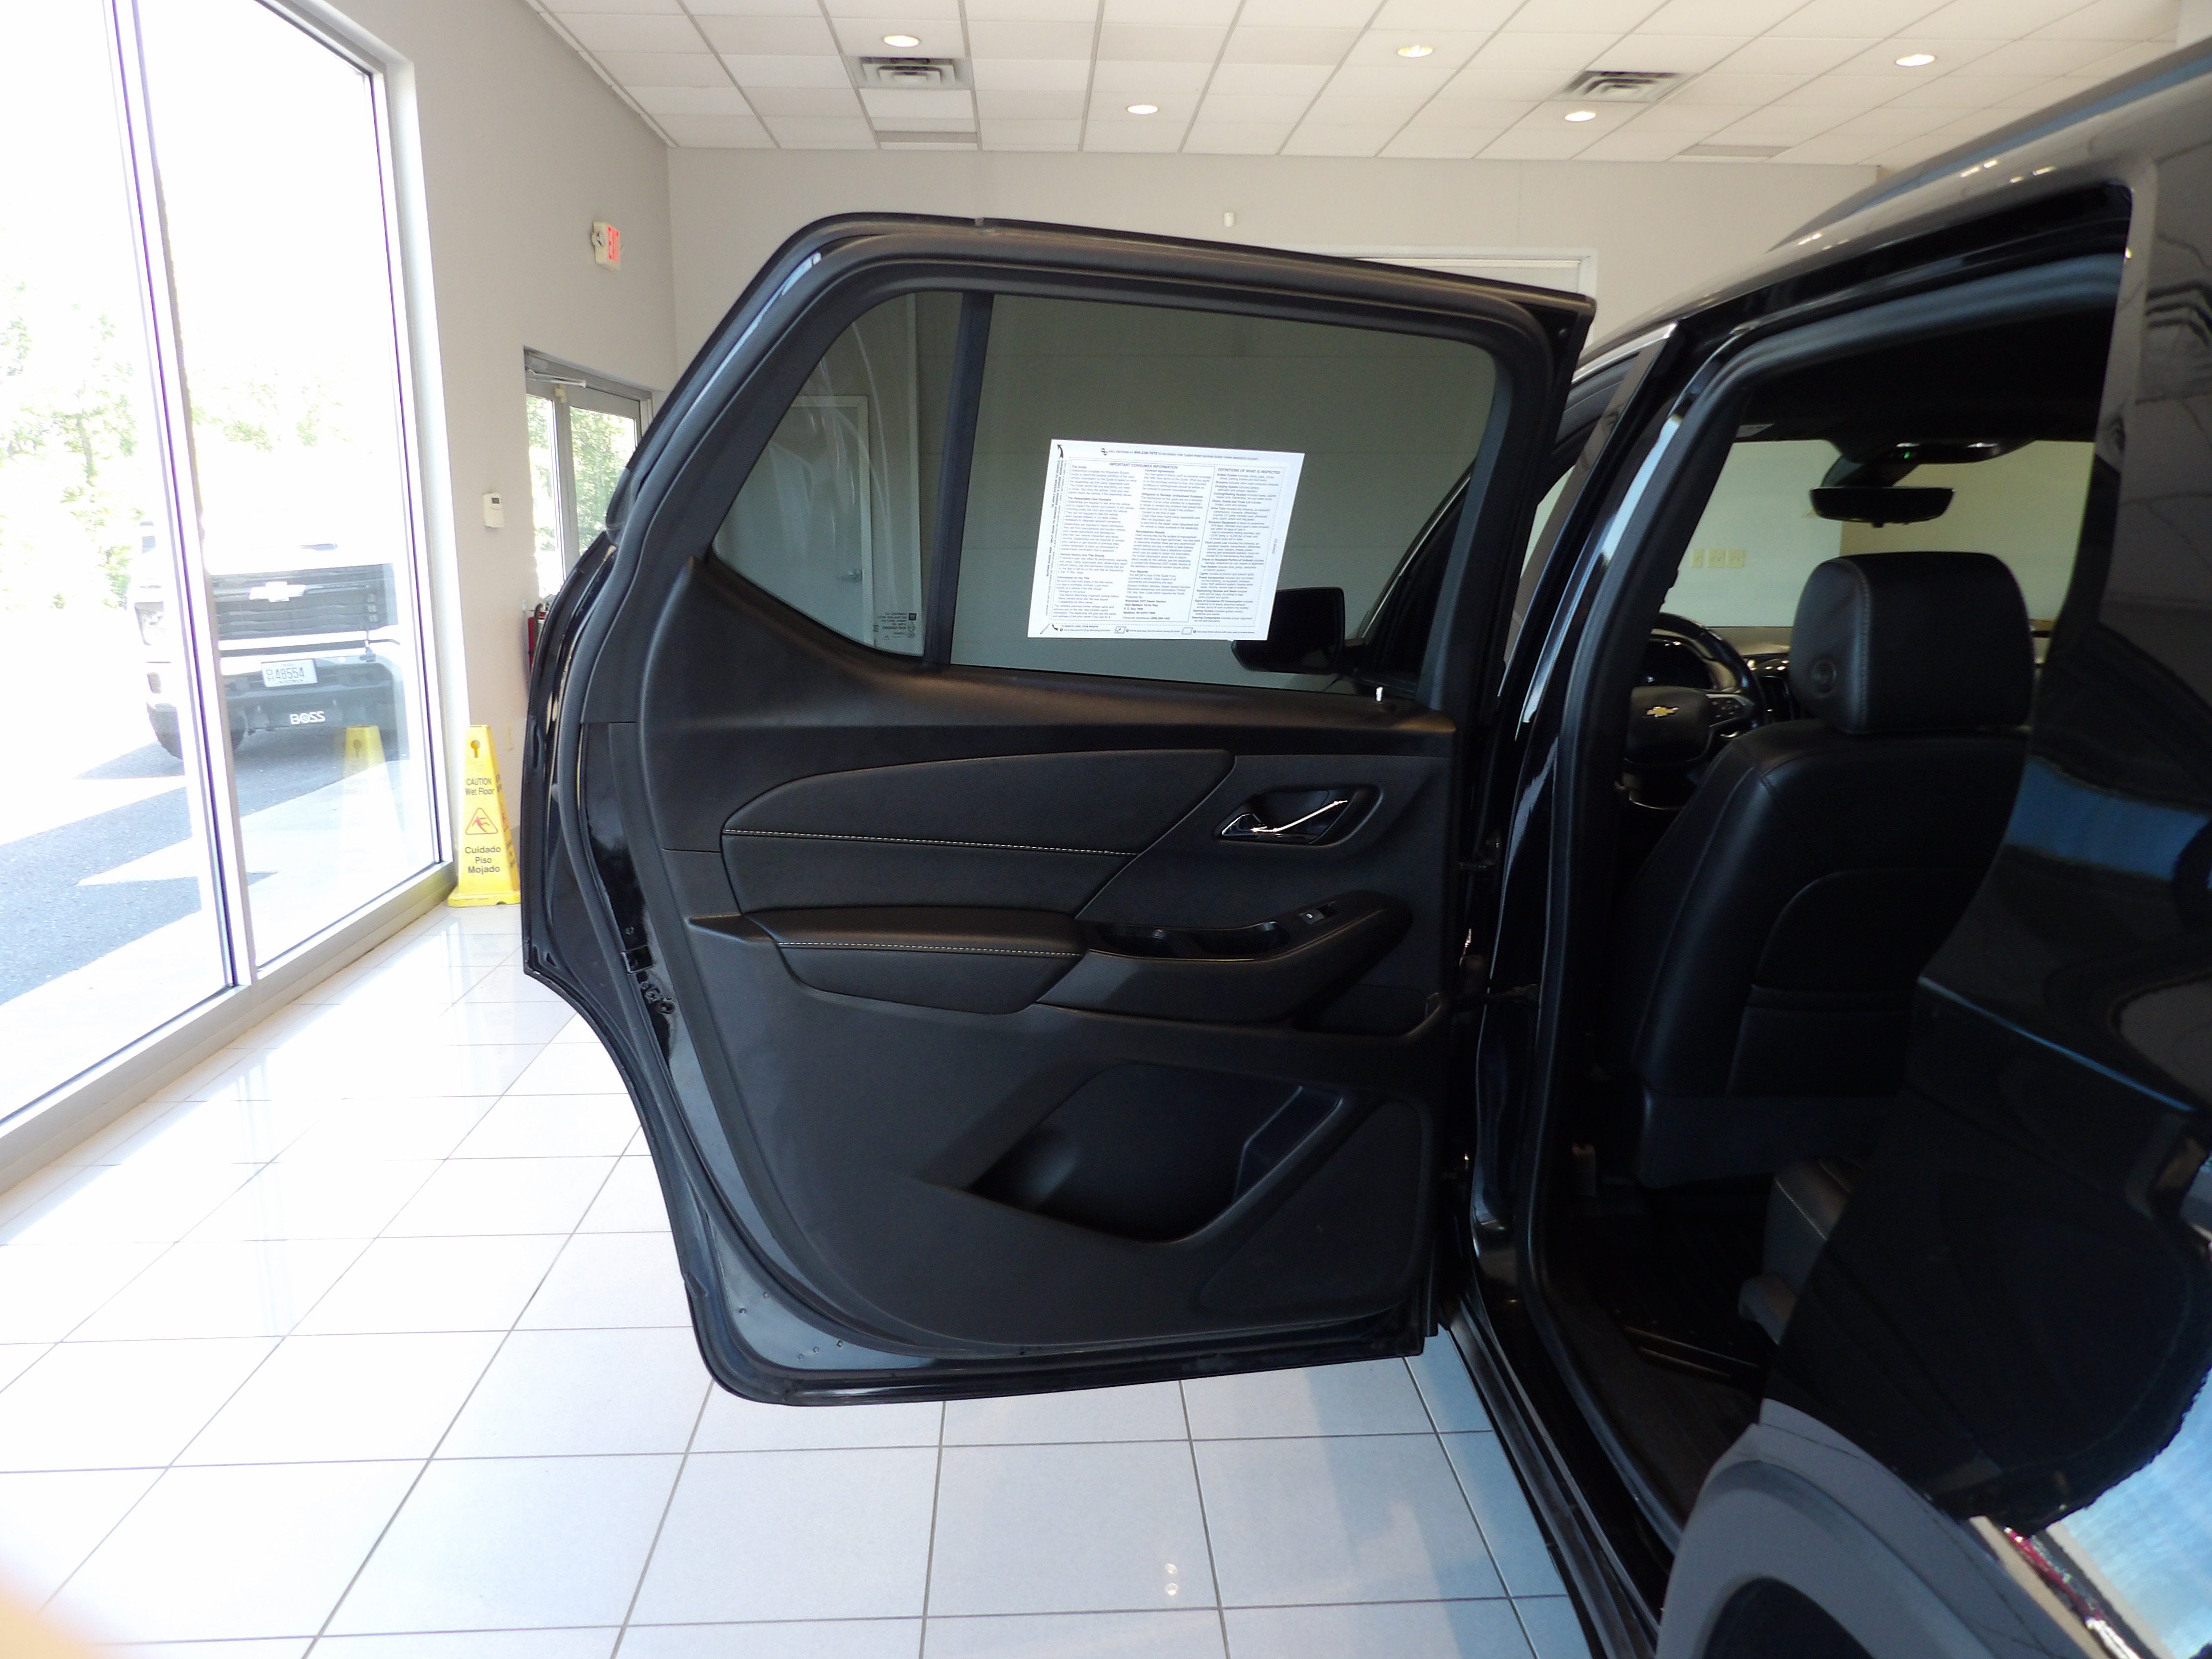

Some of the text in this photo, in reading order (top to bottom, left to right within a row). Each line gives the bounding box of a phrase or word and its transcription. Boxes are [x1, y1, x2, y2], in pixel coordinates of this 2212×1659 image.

[276, 667, 305, 679] 48554
[289, 711, 326, 725] BOSS
[465, 846, 501, 854] Cuidado
[468, 866, 500, 875] Mojado
